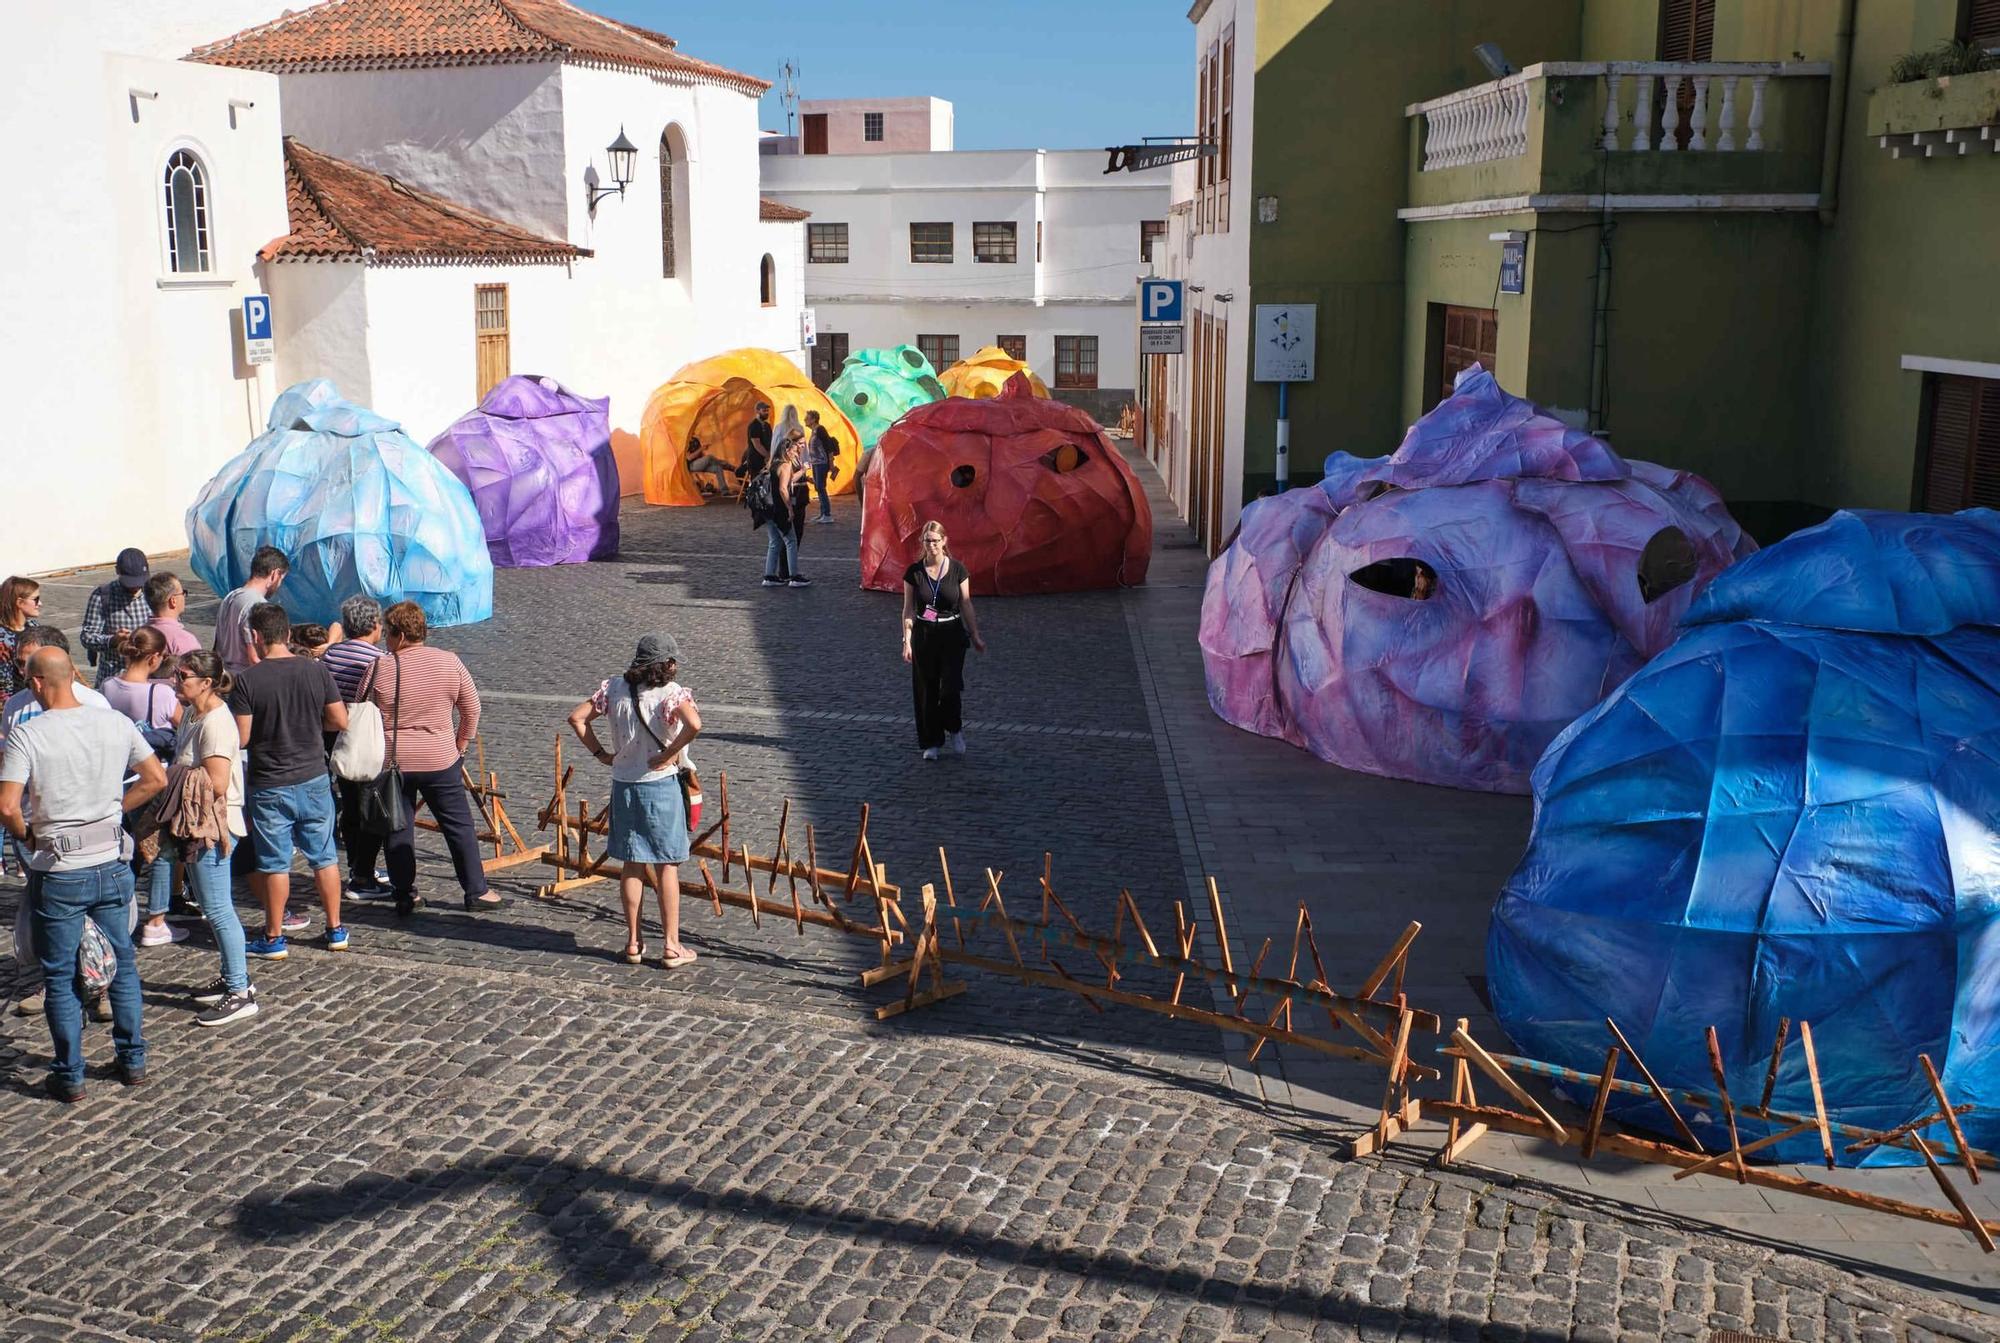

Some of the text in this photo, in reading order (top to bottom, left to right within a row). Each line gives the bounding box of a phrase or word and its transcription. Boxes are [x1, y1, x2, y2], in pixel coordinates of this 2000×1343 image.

[1139, 145, 1201, 169] LA FERRETERÍ
[1150, 285, 1174, 317] P
[249, 300, 266, 335] P
